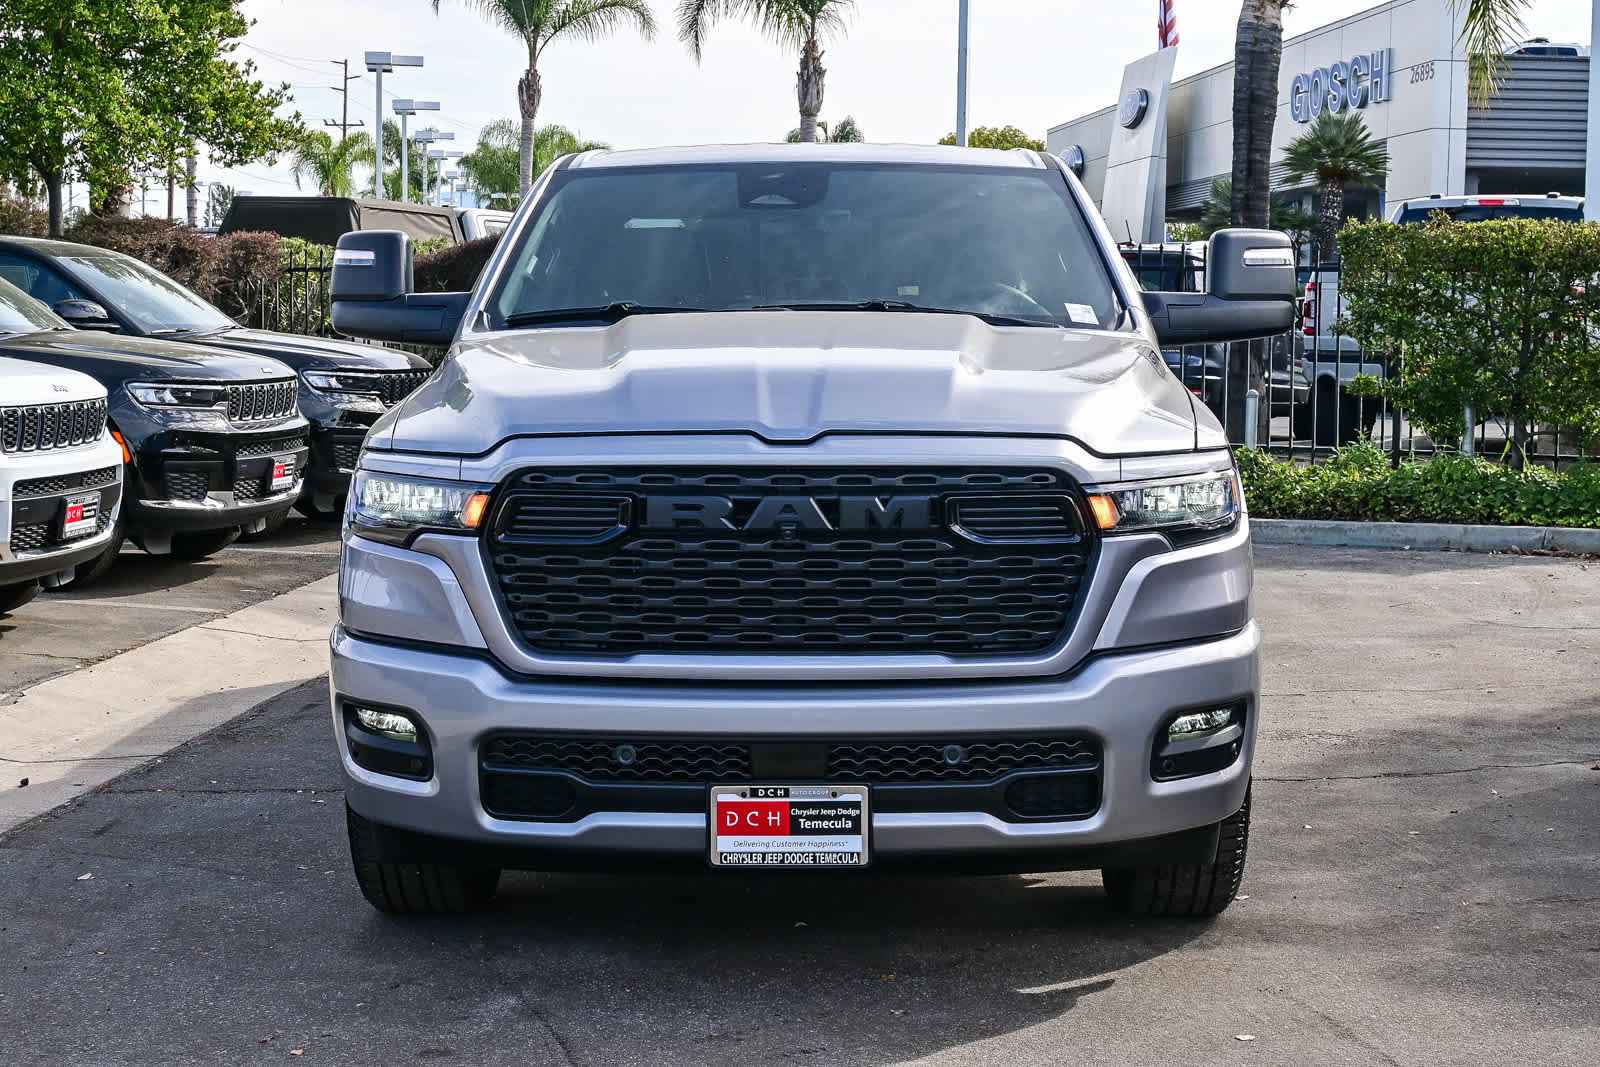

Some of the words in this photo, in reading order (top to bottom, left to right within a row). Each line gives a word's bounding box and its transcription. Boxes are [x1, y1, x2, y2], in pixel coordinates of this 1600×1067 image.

[1410, 62, 1435, 84] 26895
[1291, 48, 1394, 122] GOSCH
[67, 509, 81, 519] DCH
[646, 496, 930, 530] RAM
[791, 808, 820, 817] Chrysler
[820, 808, 836, 817] Jeep
[837, 808, 860, 816] Dodge
[799, 818, 852, 829] Temecula
[733, 840, 770, 849] Delivering
[771, 840, 806, 848] Customer
[721, 853, 763, 864] CHRYSLER
[764, 853, 783, 864] JEEP
[784, 853, 815, 864] DODGE
[815, 853, 859, 864] TEMECULA
